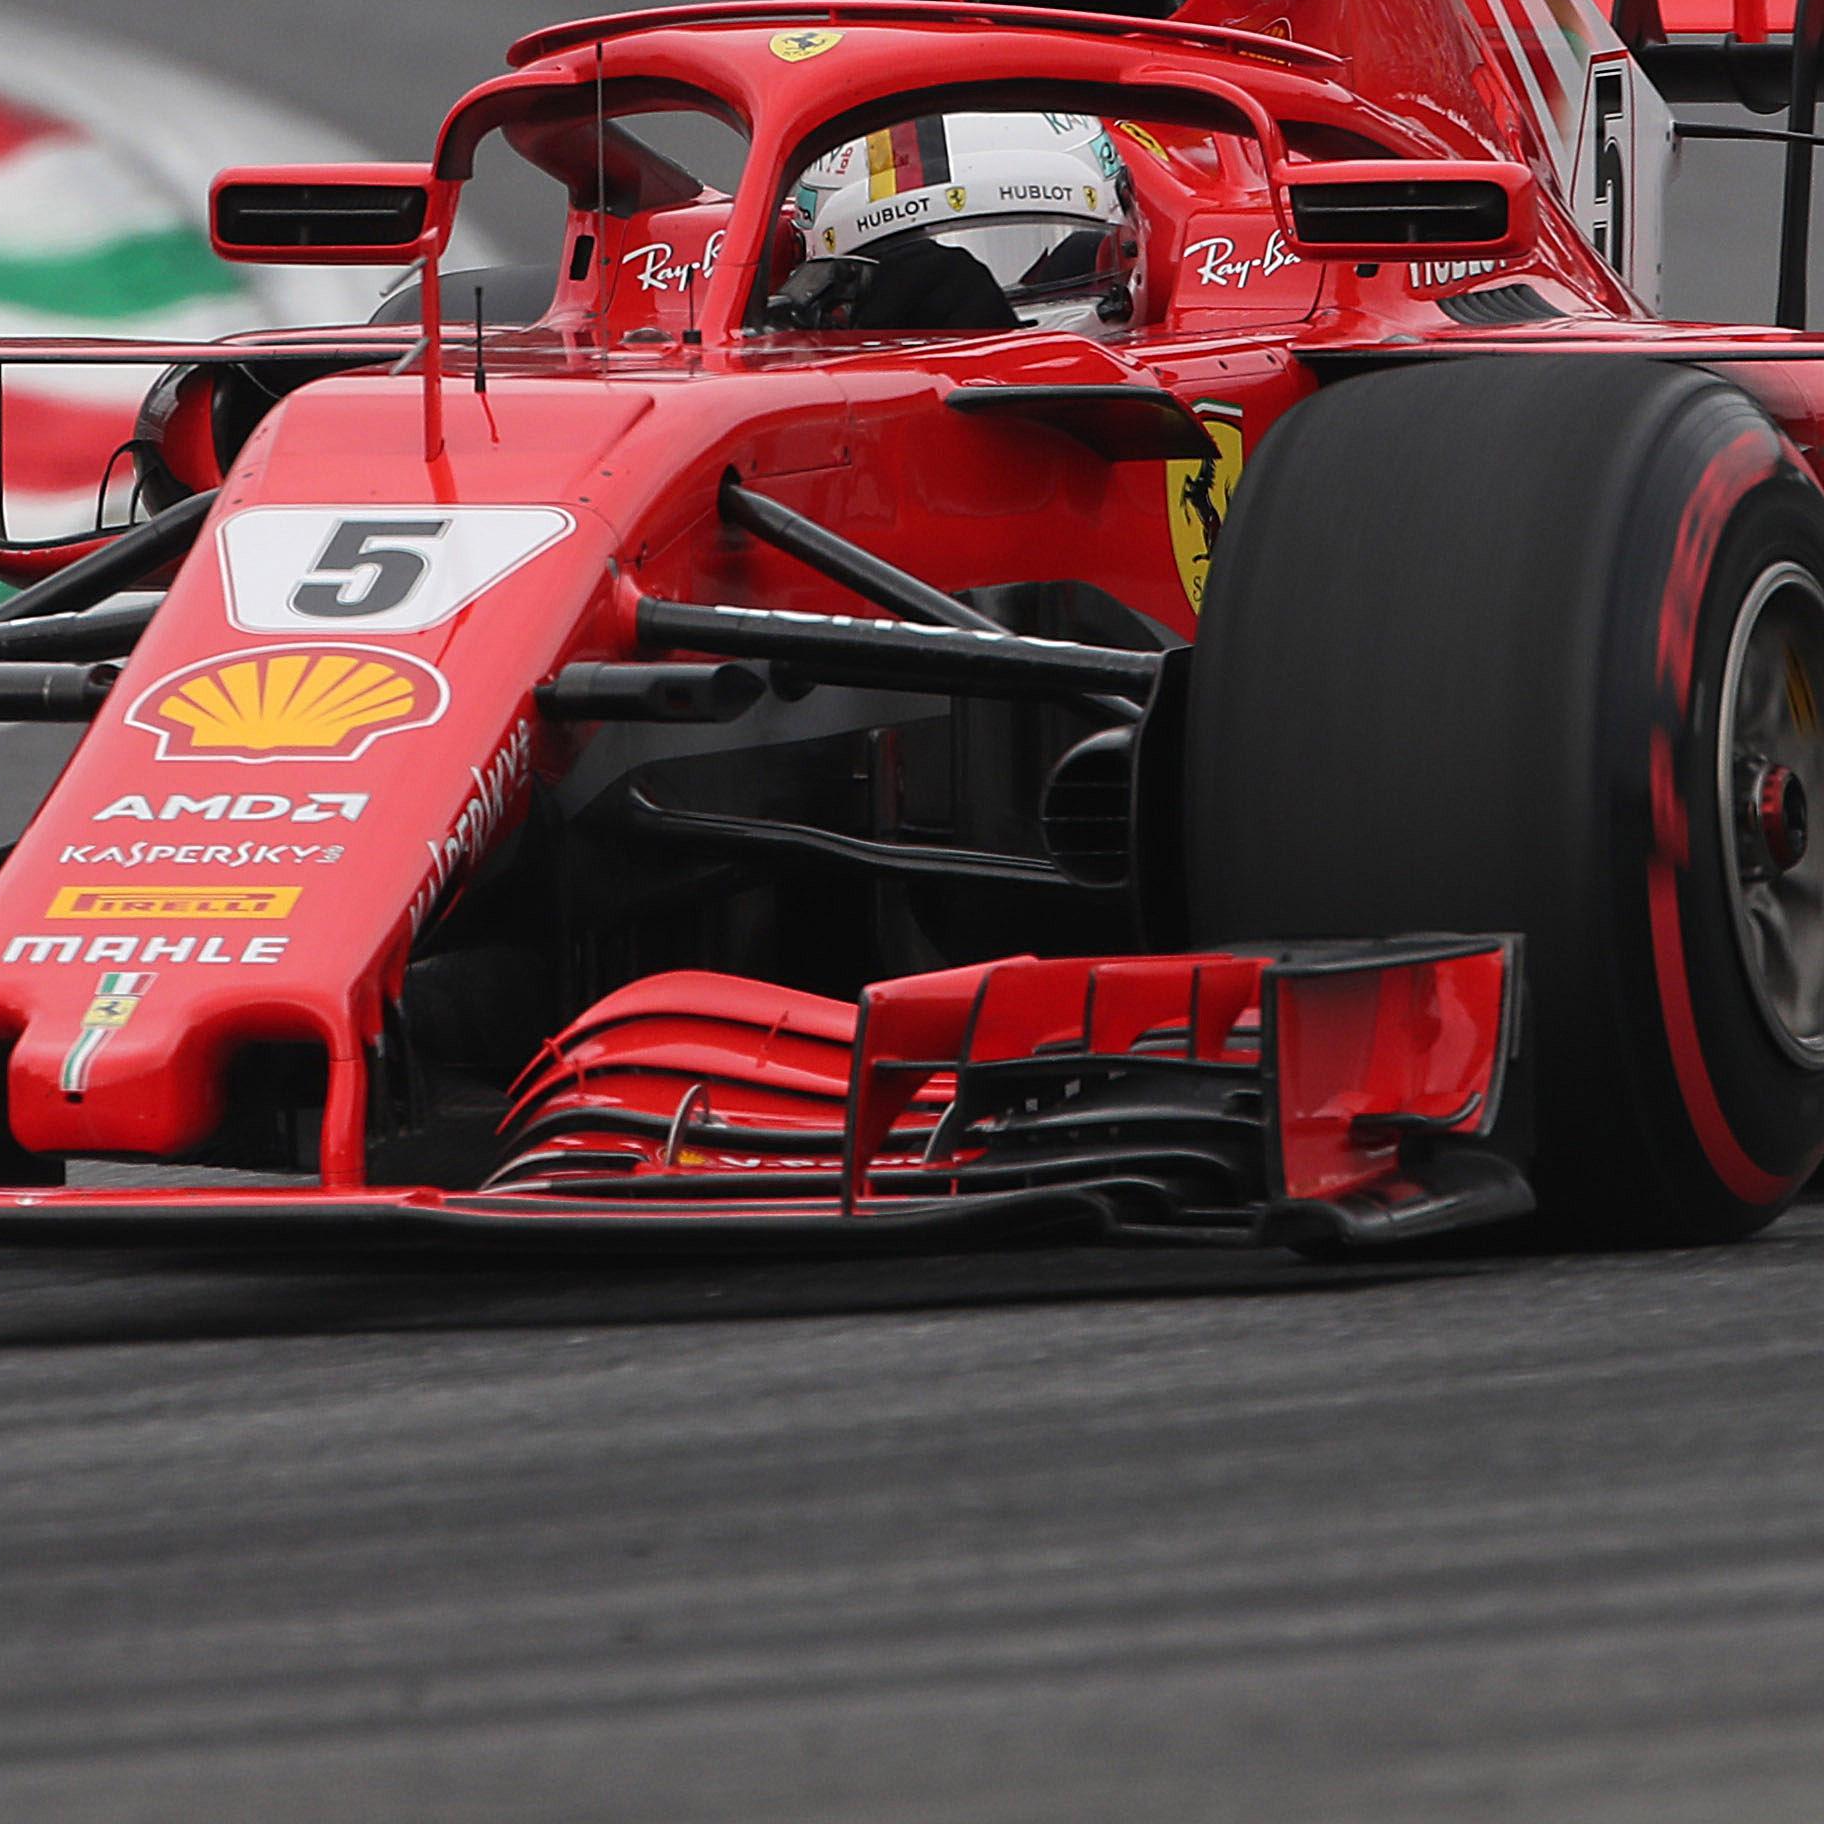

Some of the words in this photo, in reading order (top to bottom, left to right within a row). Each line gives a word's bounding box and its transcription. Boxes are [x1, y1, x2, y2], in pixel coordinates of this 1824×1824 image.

[1000, 186, 1073, 202] HUBLOT
[857, 197, 930, 231] HUBLOT
[1183, 229, 1302, 288] Ray-Ba
[287, 519, 453, 618] 5
[92, 794, 291, 821] AMD
[59, 841, 320, 867] KASPERSKY
[71, 892, 276, 912] PIRELLI
[2, 936, 290, 964] MAHLE
